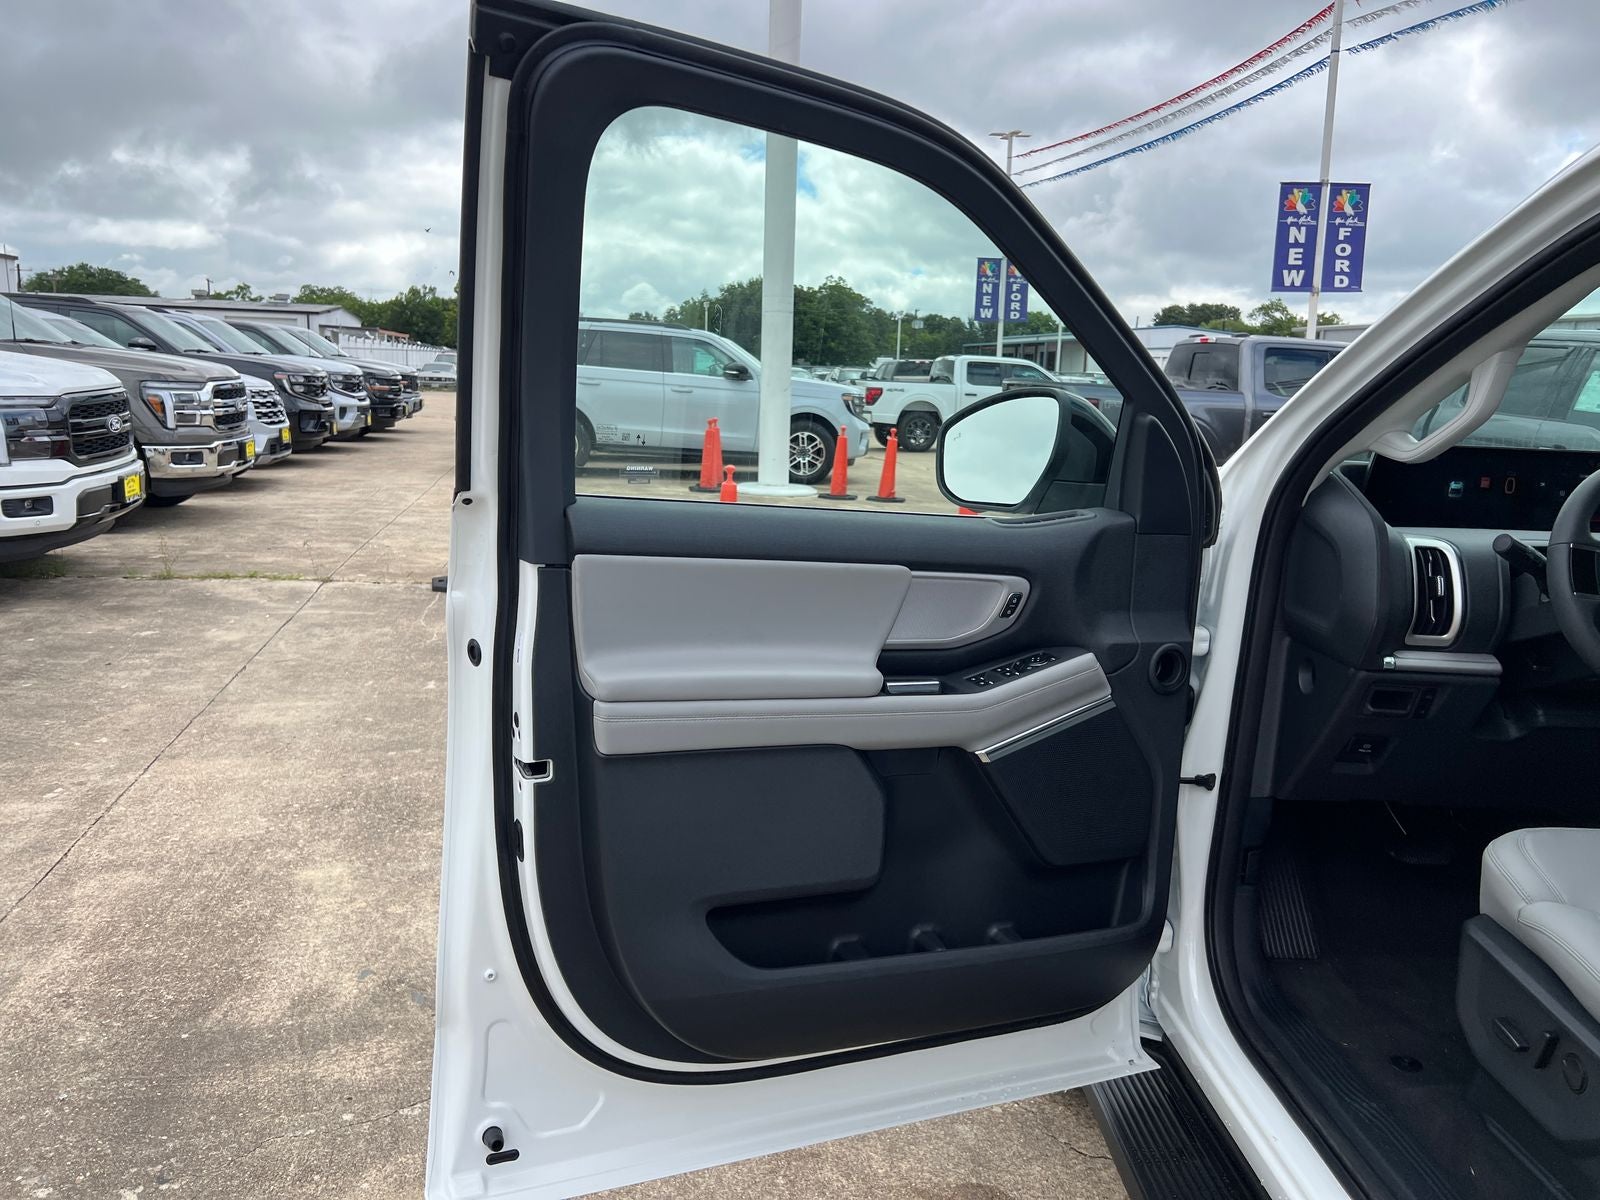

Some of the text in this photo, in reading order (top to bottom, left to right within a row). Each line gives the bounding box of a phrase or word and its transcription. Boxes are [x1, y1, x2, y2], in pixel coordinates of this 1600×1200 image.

[1282, 226, 1306, 287] NEW
[1333, 227, 1352, 288] FORD
[979, 283, 993, 319] NEW
[1009, 284, 1022, 320] FORD
